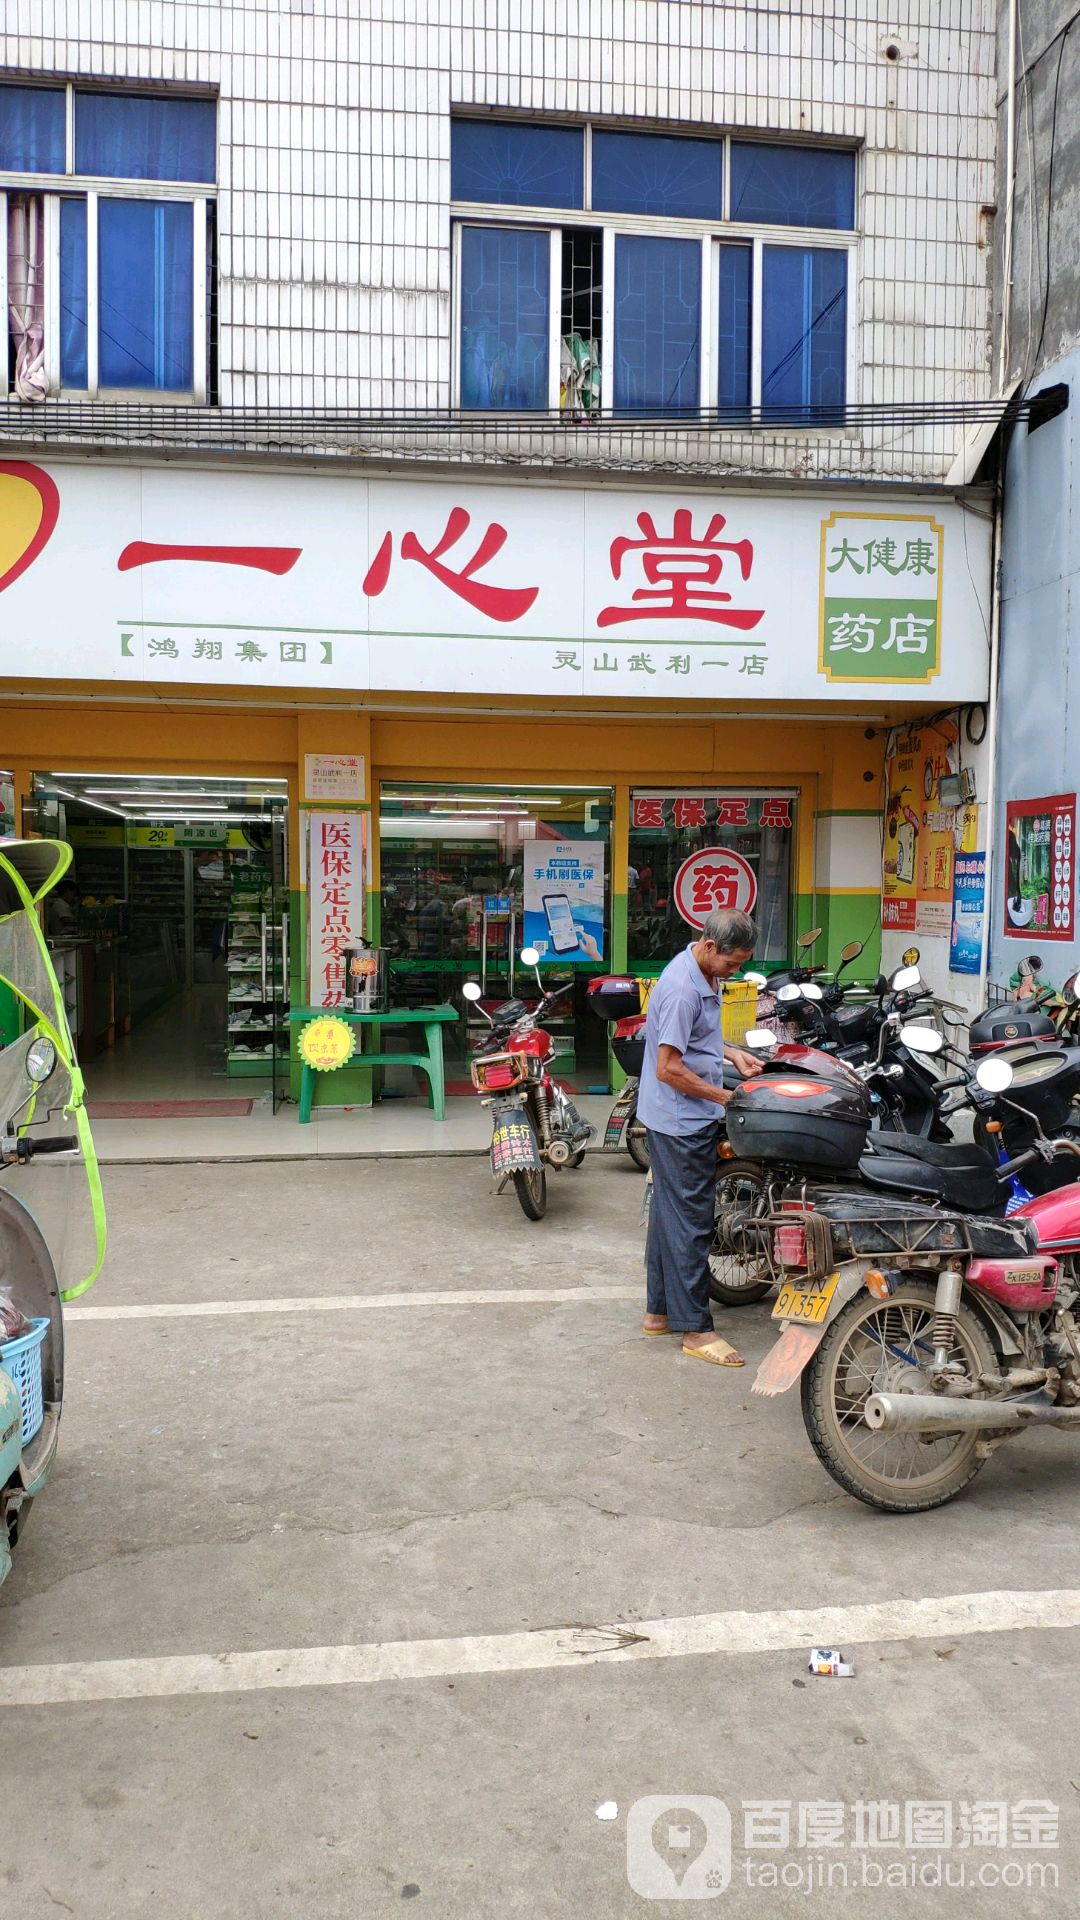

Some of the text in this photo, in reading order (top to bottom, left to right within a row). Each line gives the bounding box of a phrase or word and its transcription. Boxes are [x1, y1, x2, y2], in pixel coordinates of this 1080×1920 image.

[117, 505, 766, 631] 一心堂
[827, 536, 937, 577] 大健康
[827, 612, 936, 655] 药店
[551, 649, 769, 677] 灵山武利一店
[632, 797, 793, 829] 医保定点
[533, 868, 595, 881] 手机刷医保
[692, 865, 739, 913] 药
[776, 1293, 827, 1320] 91357
